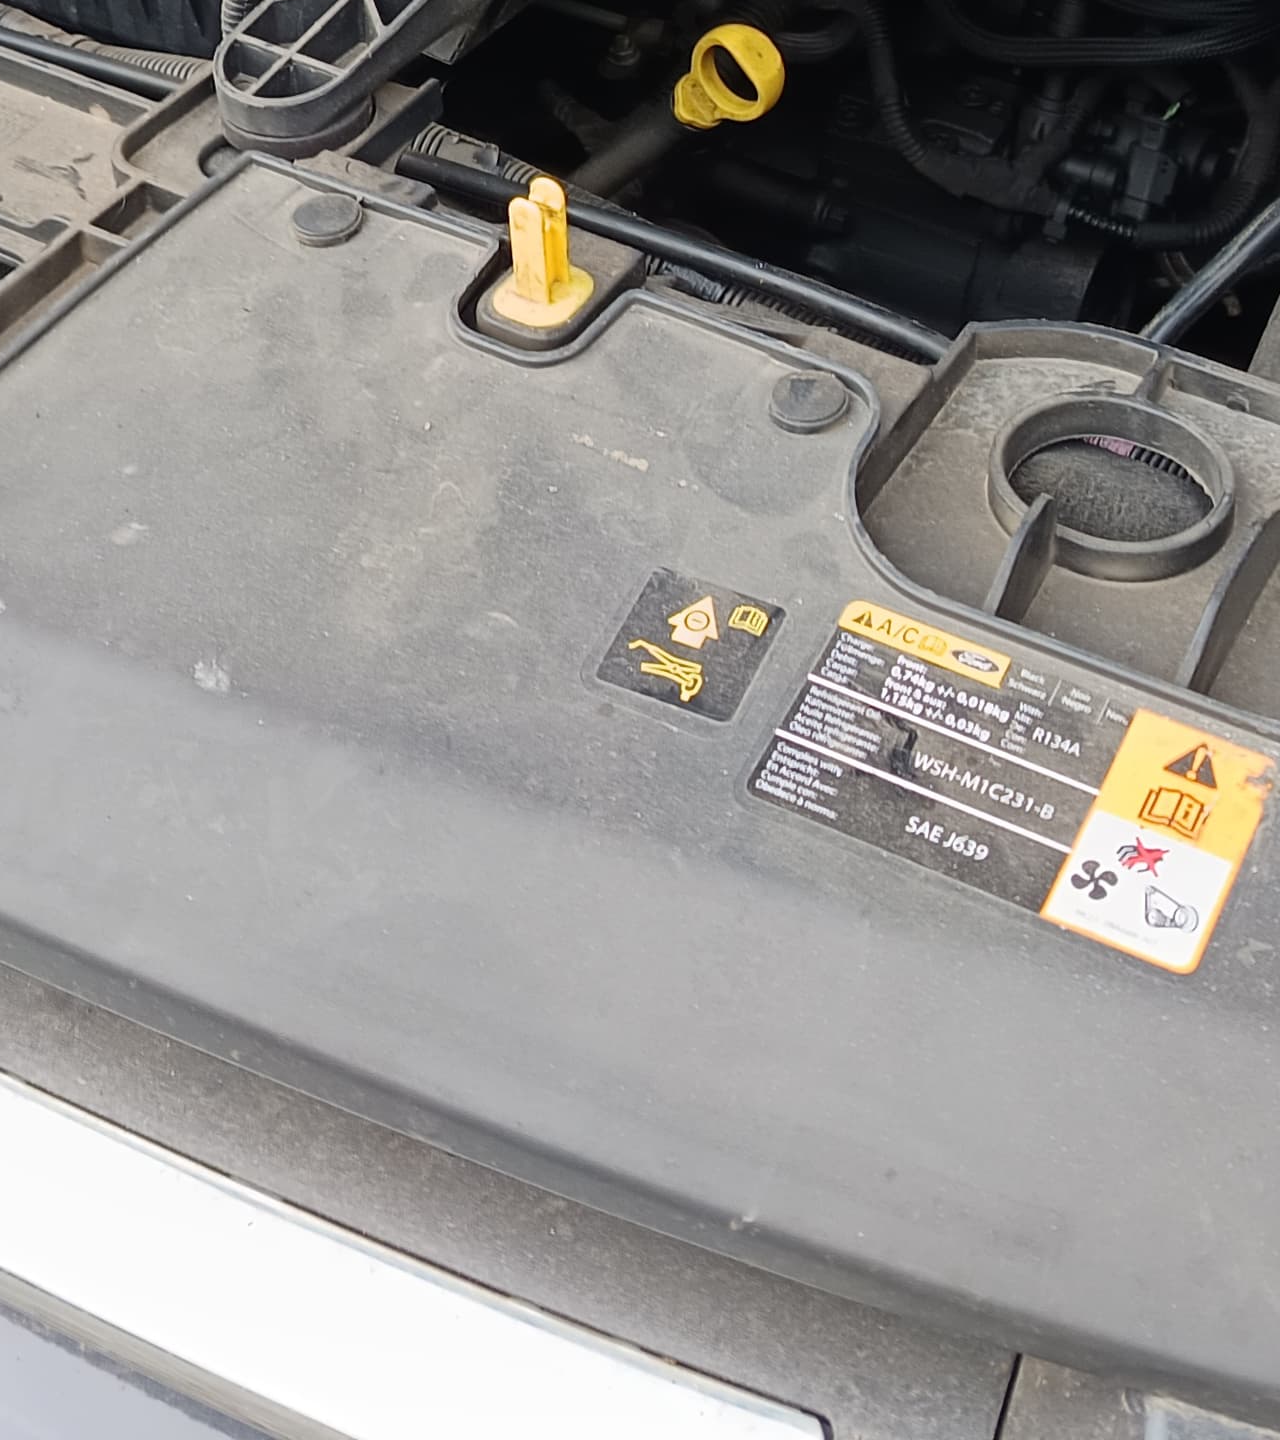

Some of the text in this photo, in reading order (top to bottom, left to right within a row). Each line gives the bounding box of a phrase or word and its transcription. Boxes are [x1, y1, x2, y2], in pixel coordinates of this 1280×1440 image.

[876, 618, 919, 644] A/C
[884, 676, 913, 696] front
[888, 665, 936, 693] 0,74kg
[936, 685, 958, 698] +/-
[925, 707, 944, 721] +/-
[944, 713, 991, 742] 0,03kg
[1032, 727, 1080, 757] R134A
[915, 752, 1054, 819] WSH-M1C231-B
[905, 816, 989, 860] SAE J639
